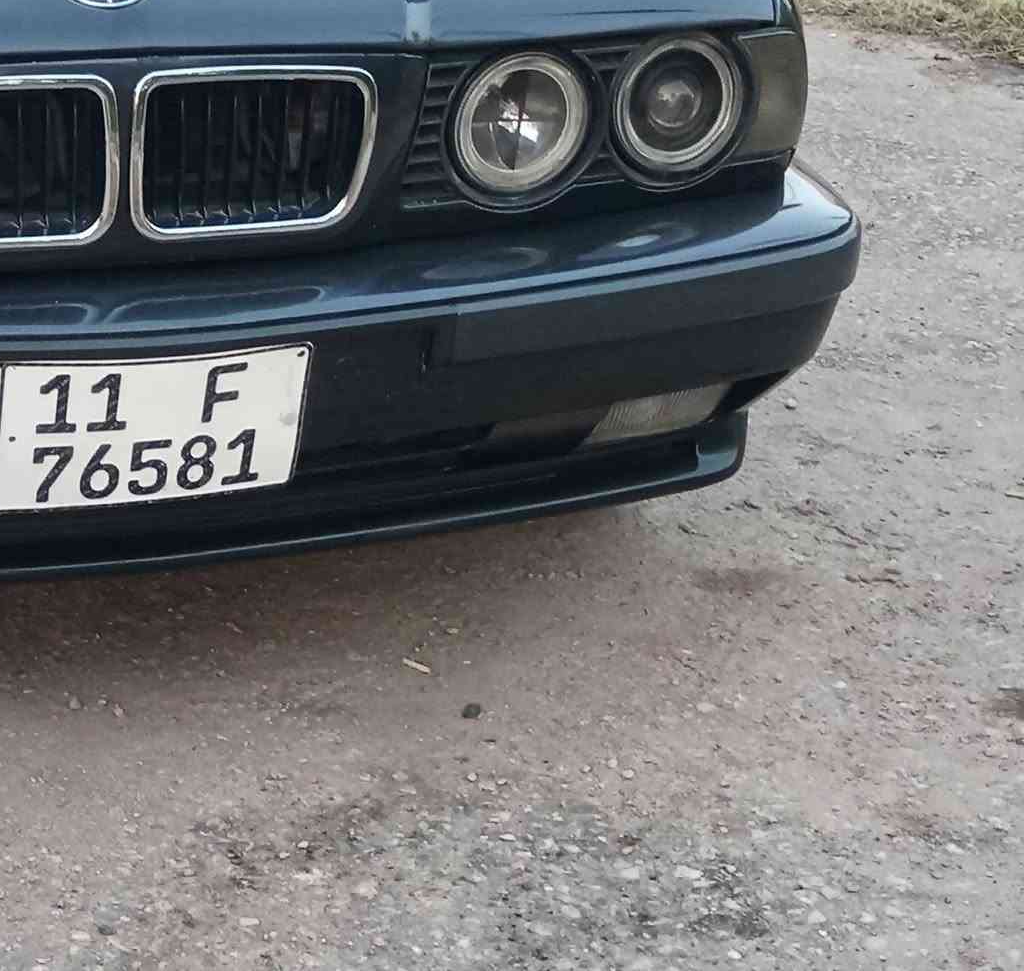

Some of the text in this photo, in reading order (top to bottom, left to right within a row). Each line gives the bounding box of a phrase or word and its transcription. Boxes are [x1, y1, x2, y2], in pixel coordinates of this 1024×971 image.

[34, 361, 249, 434] 11 F
[32, 428, 259, 503] 76581
